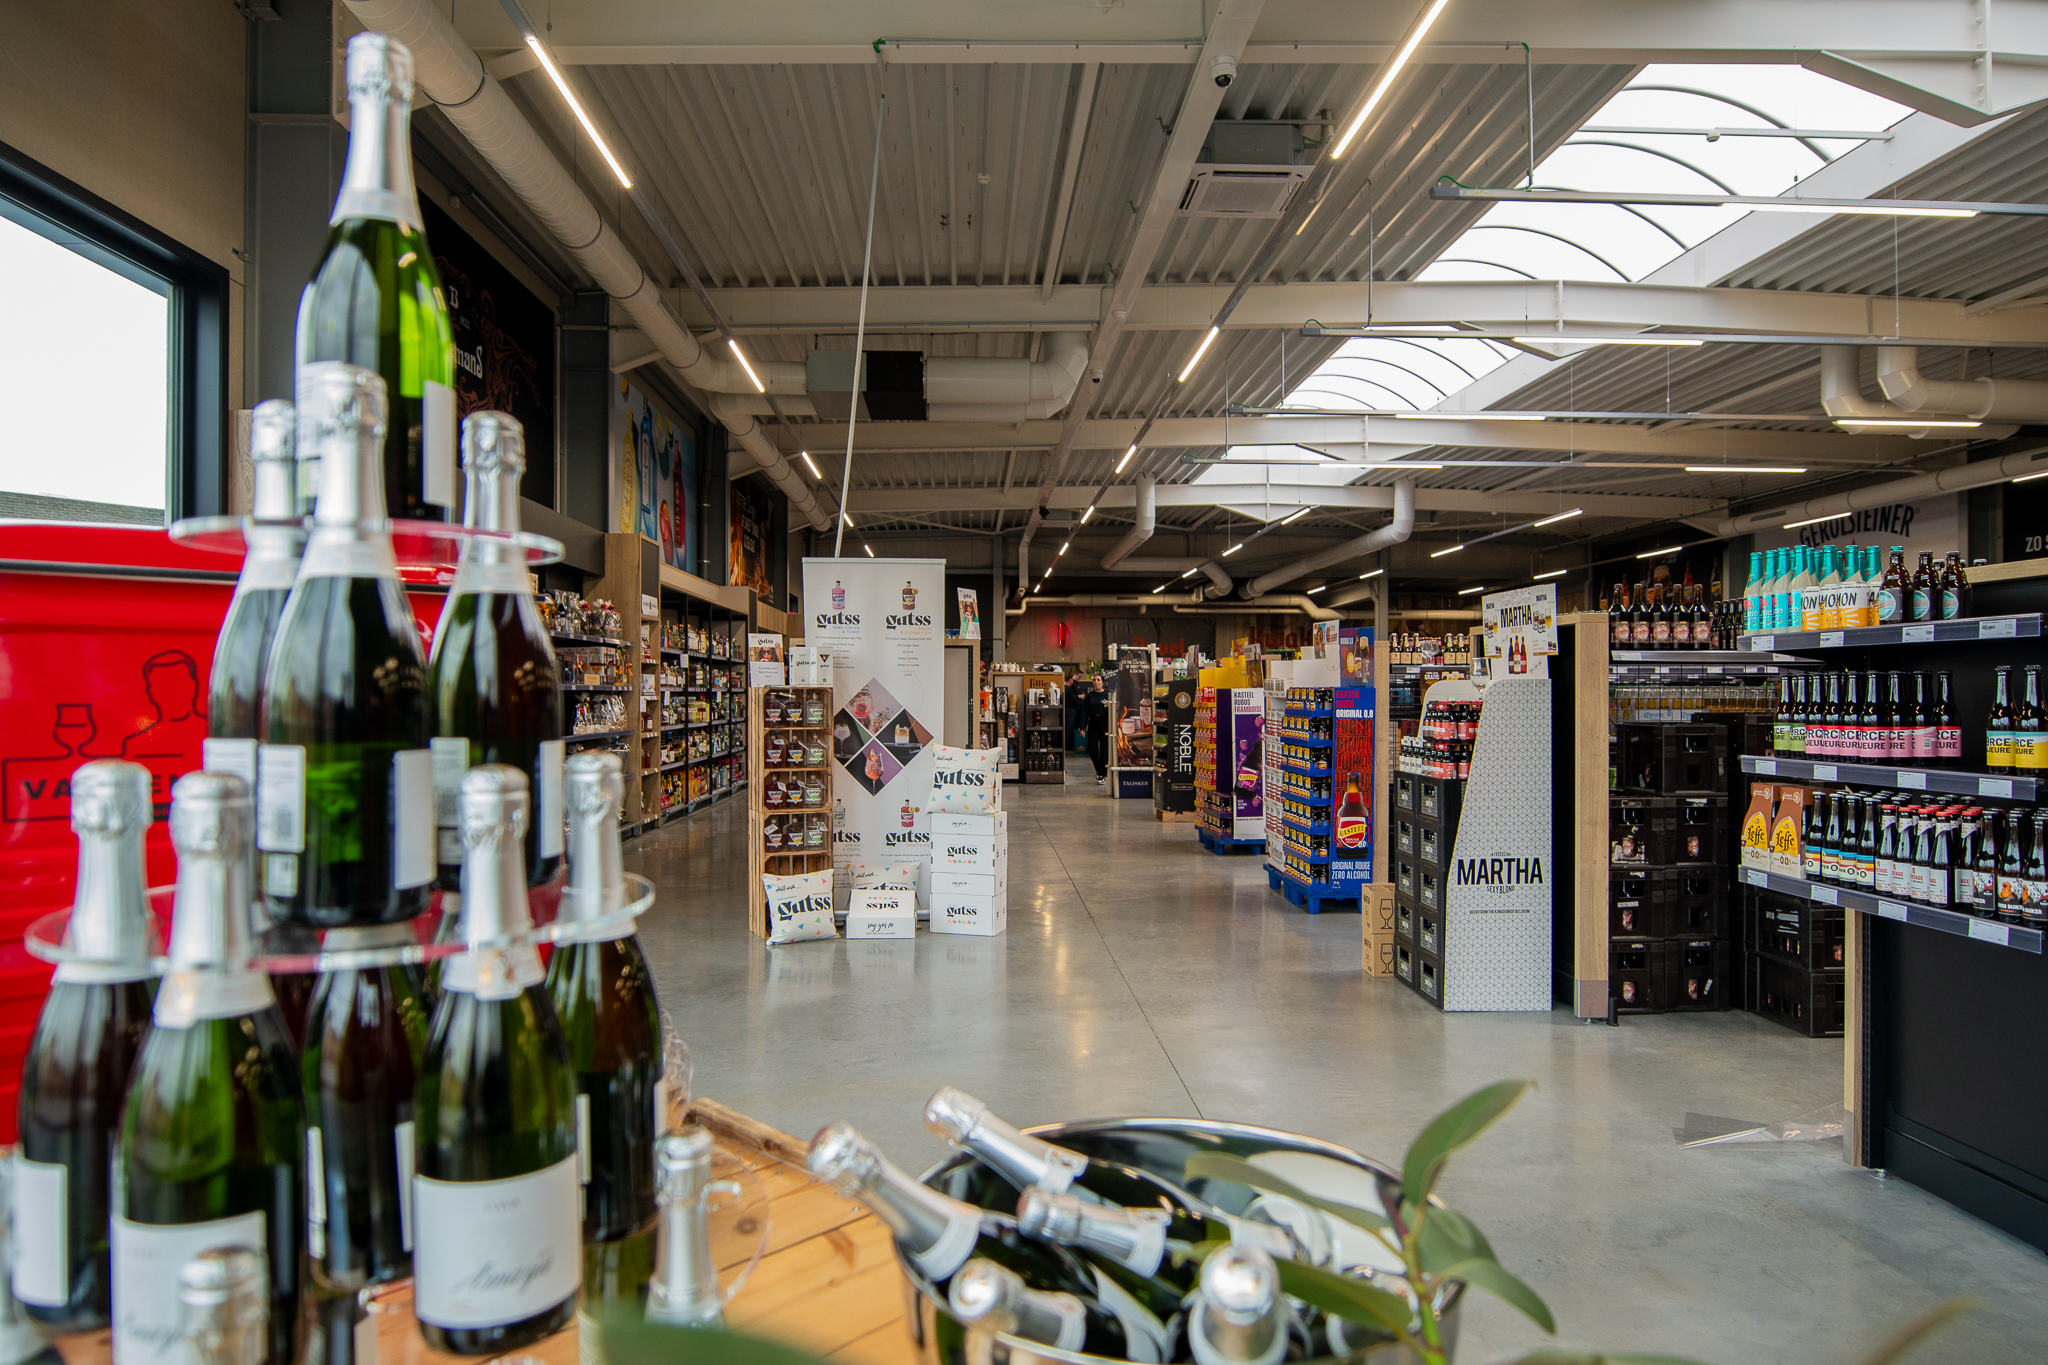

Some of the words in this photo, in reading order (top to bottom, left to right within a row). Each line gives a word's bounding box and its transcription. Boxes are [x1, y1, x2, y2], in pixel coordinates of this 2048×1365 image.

[816, 611, 860, 629] gutss
[886, 612, 931, 630] gutss
[1500, 604, 1532, 628] MARTHA
[1132, 636, 1184, 656] Dvel
[1336, 690, 1360, 699] KASTEEL
[1336, 700, 1354, 708] ROUGE
[1336, 709, 1362, 718] ORIGINAL
[1364, 709, 1373, 718] 0.0
[1180, 724, 1192, 772] NOBLE
[933, 768, 986, 790] gutss
[1340, 825, 1364, 836] KASTEEL
[1748, 825, 1764, 845] Leffe
[885, 830, 930, 847] gutss
[1776, 831, 1794, 851] Leffe
[947, 845, 977, 857] gutss
[1332, 861, 1354, 870] ORIGINAL
[1355, 862, 1370, 870] ROUGE
[1457, 858, 1543, 885] MARTHA
[1332, 871, 1345, 879] ZERO
[1346, 871, 1370, 879] ALCOHOL
[1487, 885, 1499, 893] SEXY
[1500, 885, 1515, 894] BLOND
[777, 894, 831, 922] gutss
[866, 901, 899, 910] gutss
[947, 906, 977, 917] gutss
[867, 922, 877, 932] say
[878, 922, 887, 932] yes
